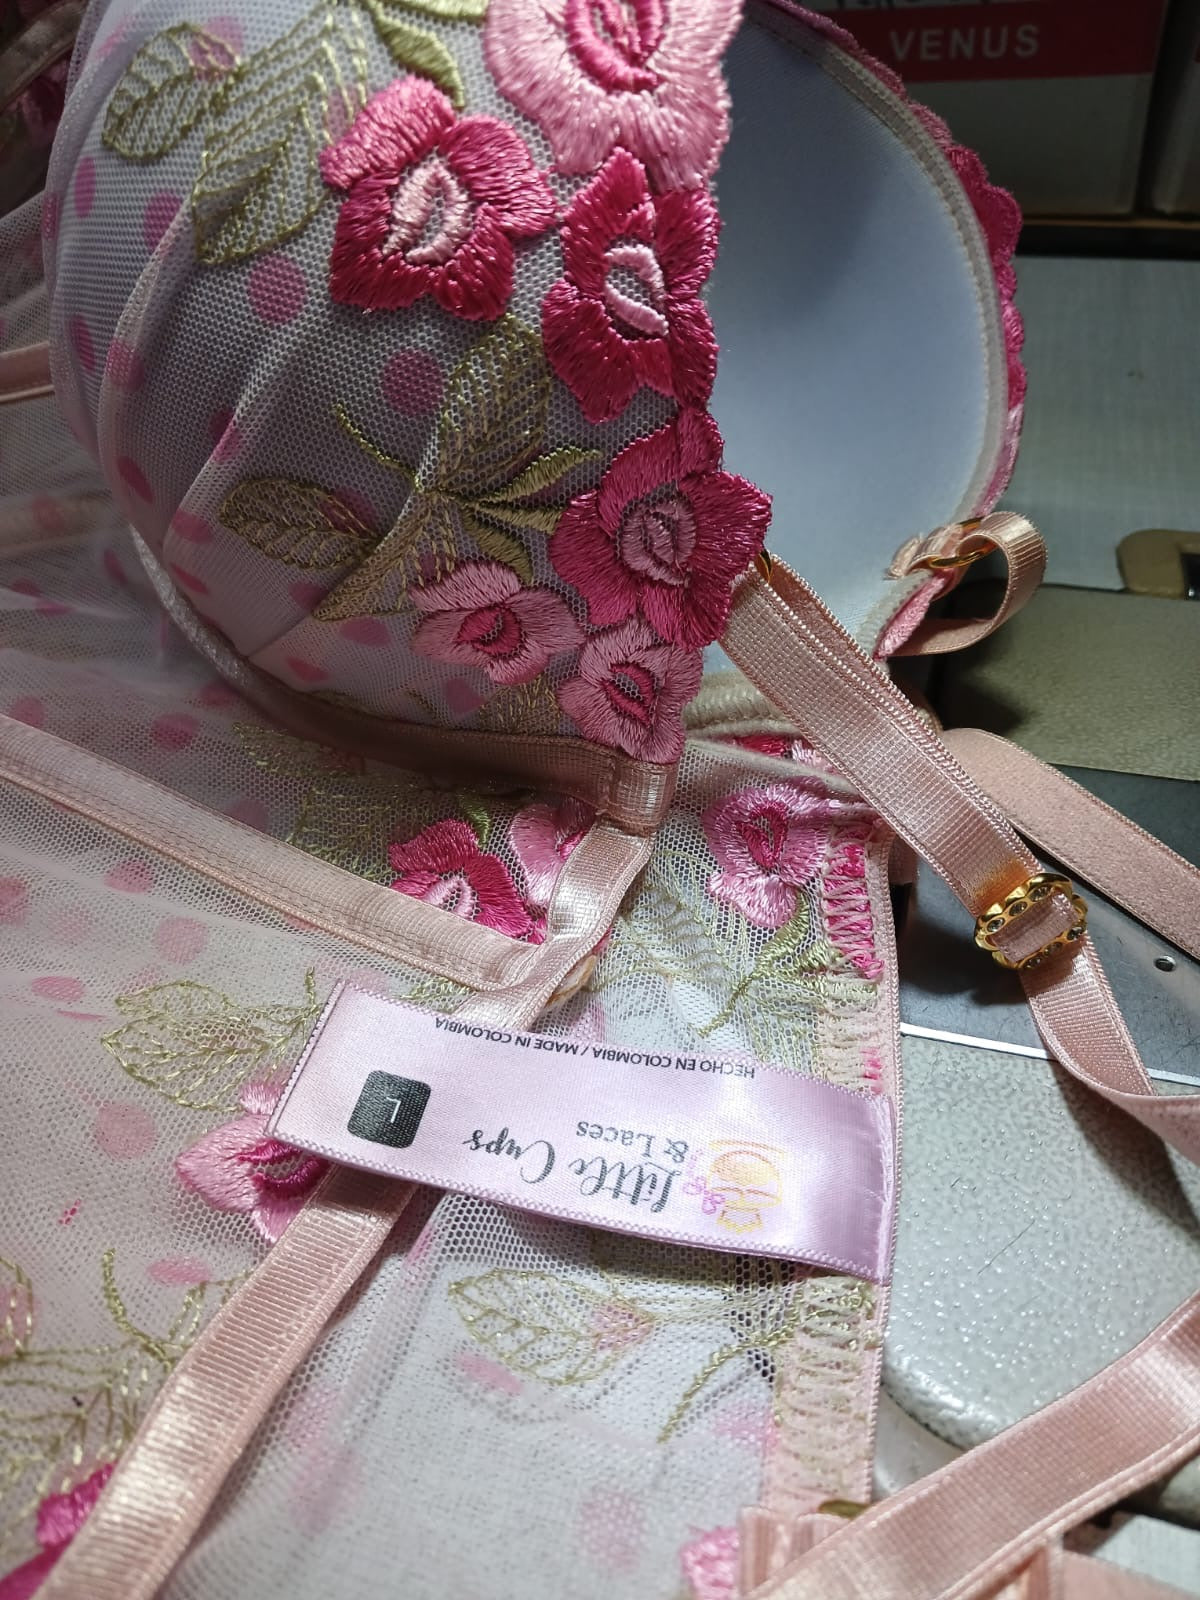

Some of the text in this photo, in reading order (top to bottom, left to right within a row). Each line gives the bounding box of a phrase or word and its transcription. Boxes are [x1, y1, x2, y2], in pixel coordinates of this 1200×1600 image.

[889, 25, 1041, 61] VENUS
[434, 1016, 513, 1044] COLOMBIA
[515, 1035, 532, 1049] IN
[534, 1037, 580, 1056] MADE
[592, 1046, 672, 1068] COLOMBIA
[675, 1057, 697, 1072] EN
[699, 1058, 756, 1079] HECHO
[387, 1097, 402, 1125] L
[576, 1120, 690, 1165] & Laces
[461, 1127, 682, 1214] Little Cups
